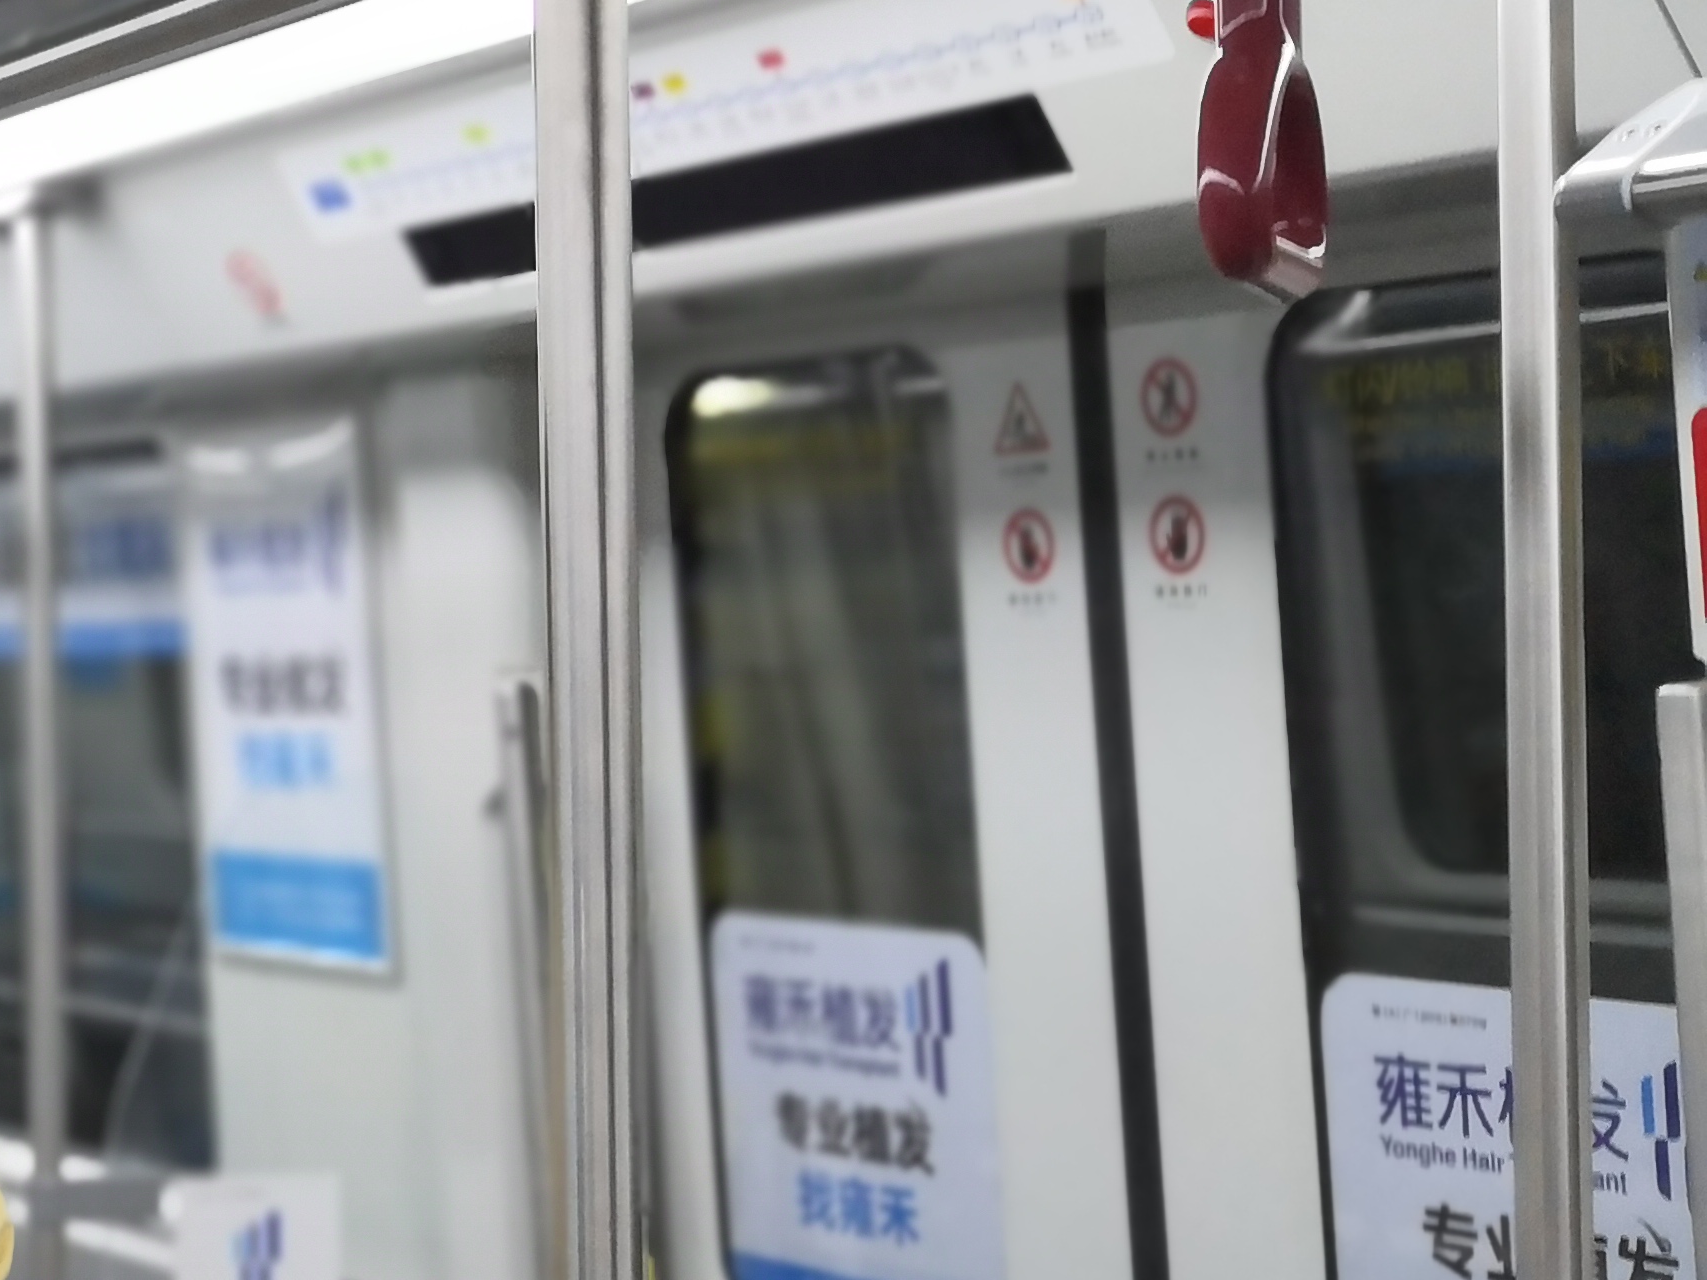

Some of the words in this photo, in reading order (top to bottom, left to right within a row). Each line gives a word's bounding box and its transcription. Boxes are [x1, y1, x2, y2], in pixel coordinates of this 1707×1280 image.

[775, 1092, 935, 1178] 专业植发
[1375, 1051, 1629, 1162] 雍禾发
[1380, 1134, 1456, 1169] Yonghe
